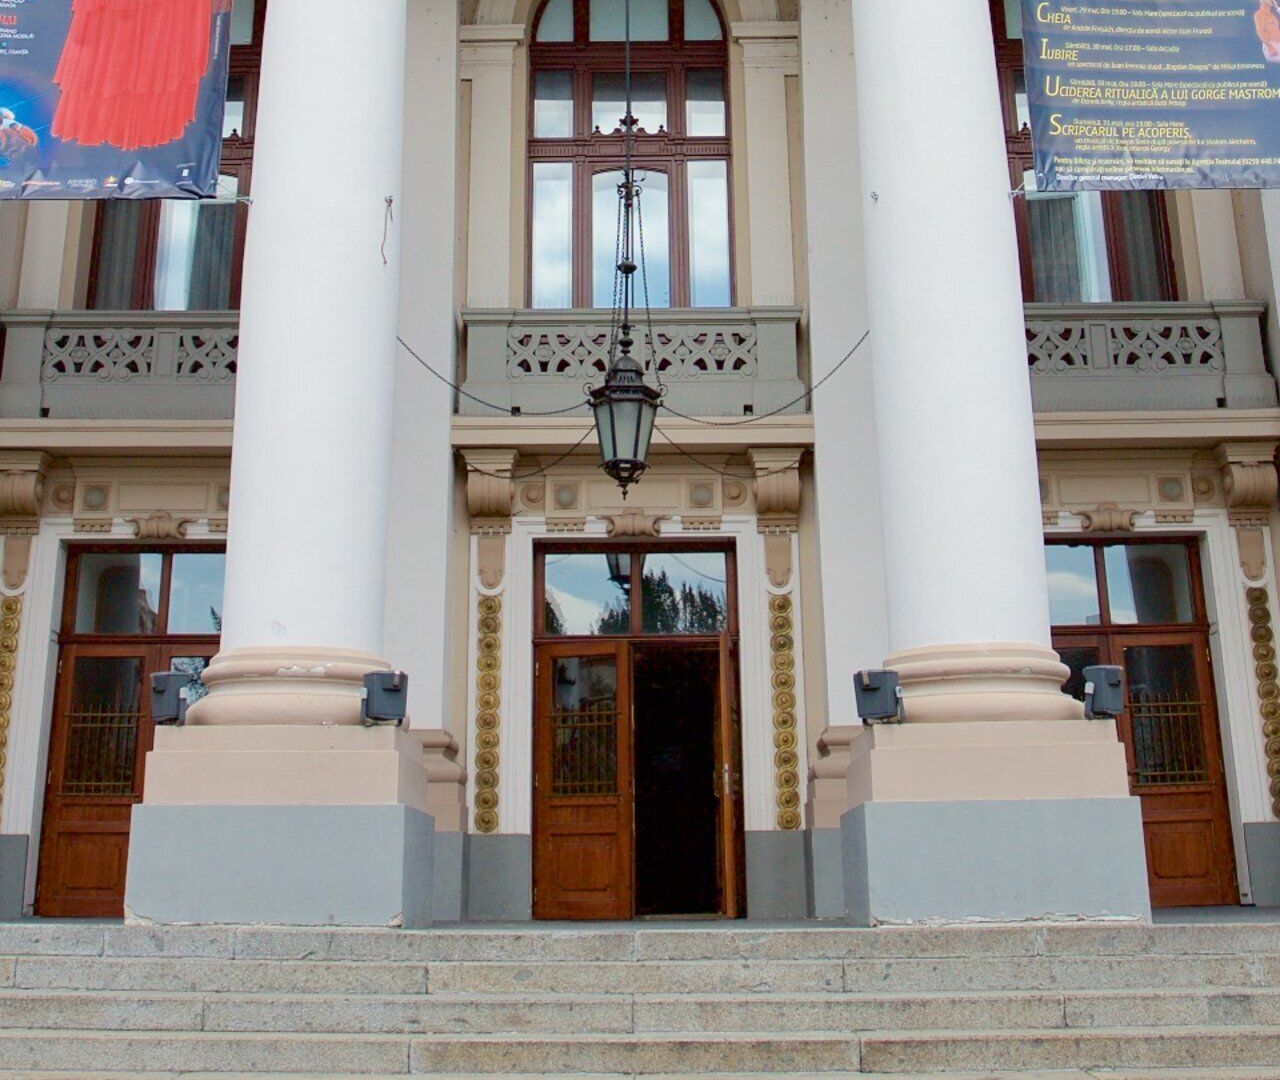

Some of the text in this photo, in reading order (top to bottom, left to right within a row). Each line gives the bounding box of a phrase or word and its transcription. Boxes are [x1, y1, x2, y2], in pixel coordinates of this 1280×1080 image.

[1036, 1, 1072, 24] CHEIA
[1040, 38, 1079, 60] IUBIRE
[1045, 75, 1102, 98] UCIDEREA
[1104, 87, 1158, 100] RITUALICĂ
[1160, 88, 1169, 100] A
[1171, 88, 1188, 100] LUI
[1191, 88, 1226, 100] GORGE
[1049, 113, 1119, 137] SCRIPCARUL
[1122, 127, 1136, 137] PE
